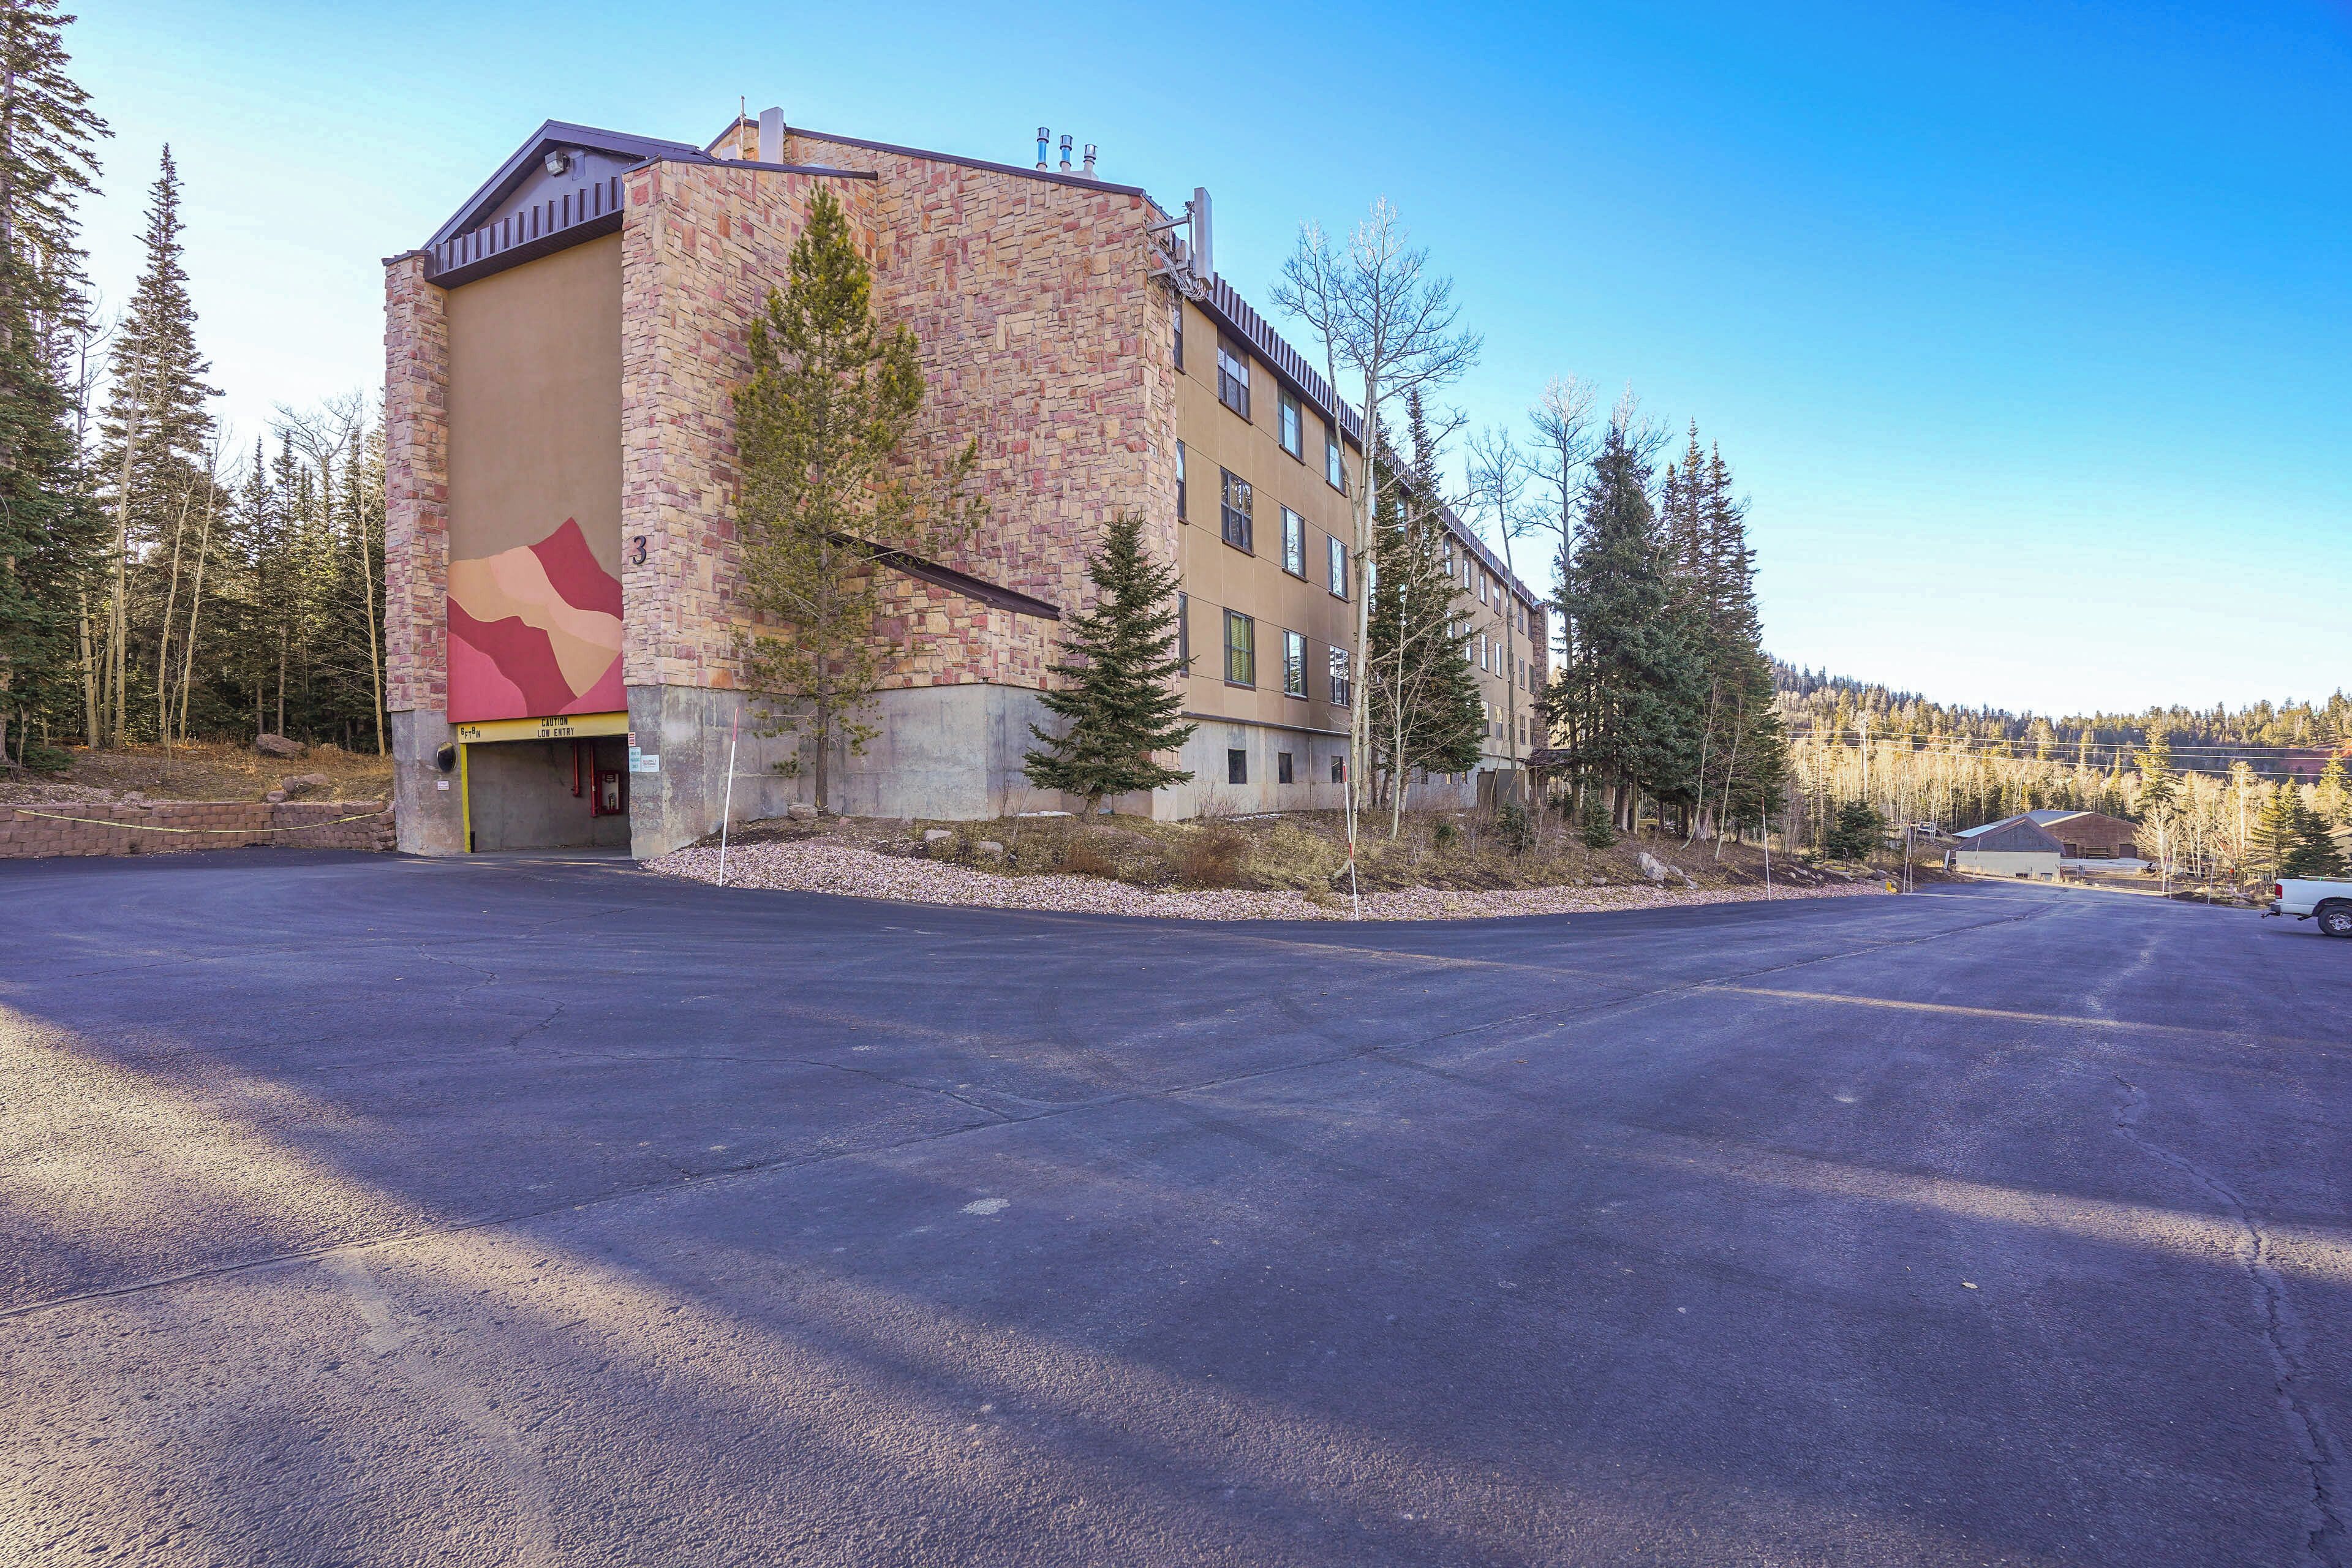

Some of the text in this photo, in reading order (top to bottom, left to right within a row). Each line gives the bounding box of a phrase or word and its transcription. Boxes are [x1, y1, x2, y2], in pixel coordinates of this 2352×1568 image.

[633, 535, 647, 565] 3
[541, 717, 568, 727] CAUTION
[537, 727, 575, 737] LOW ENTRY
